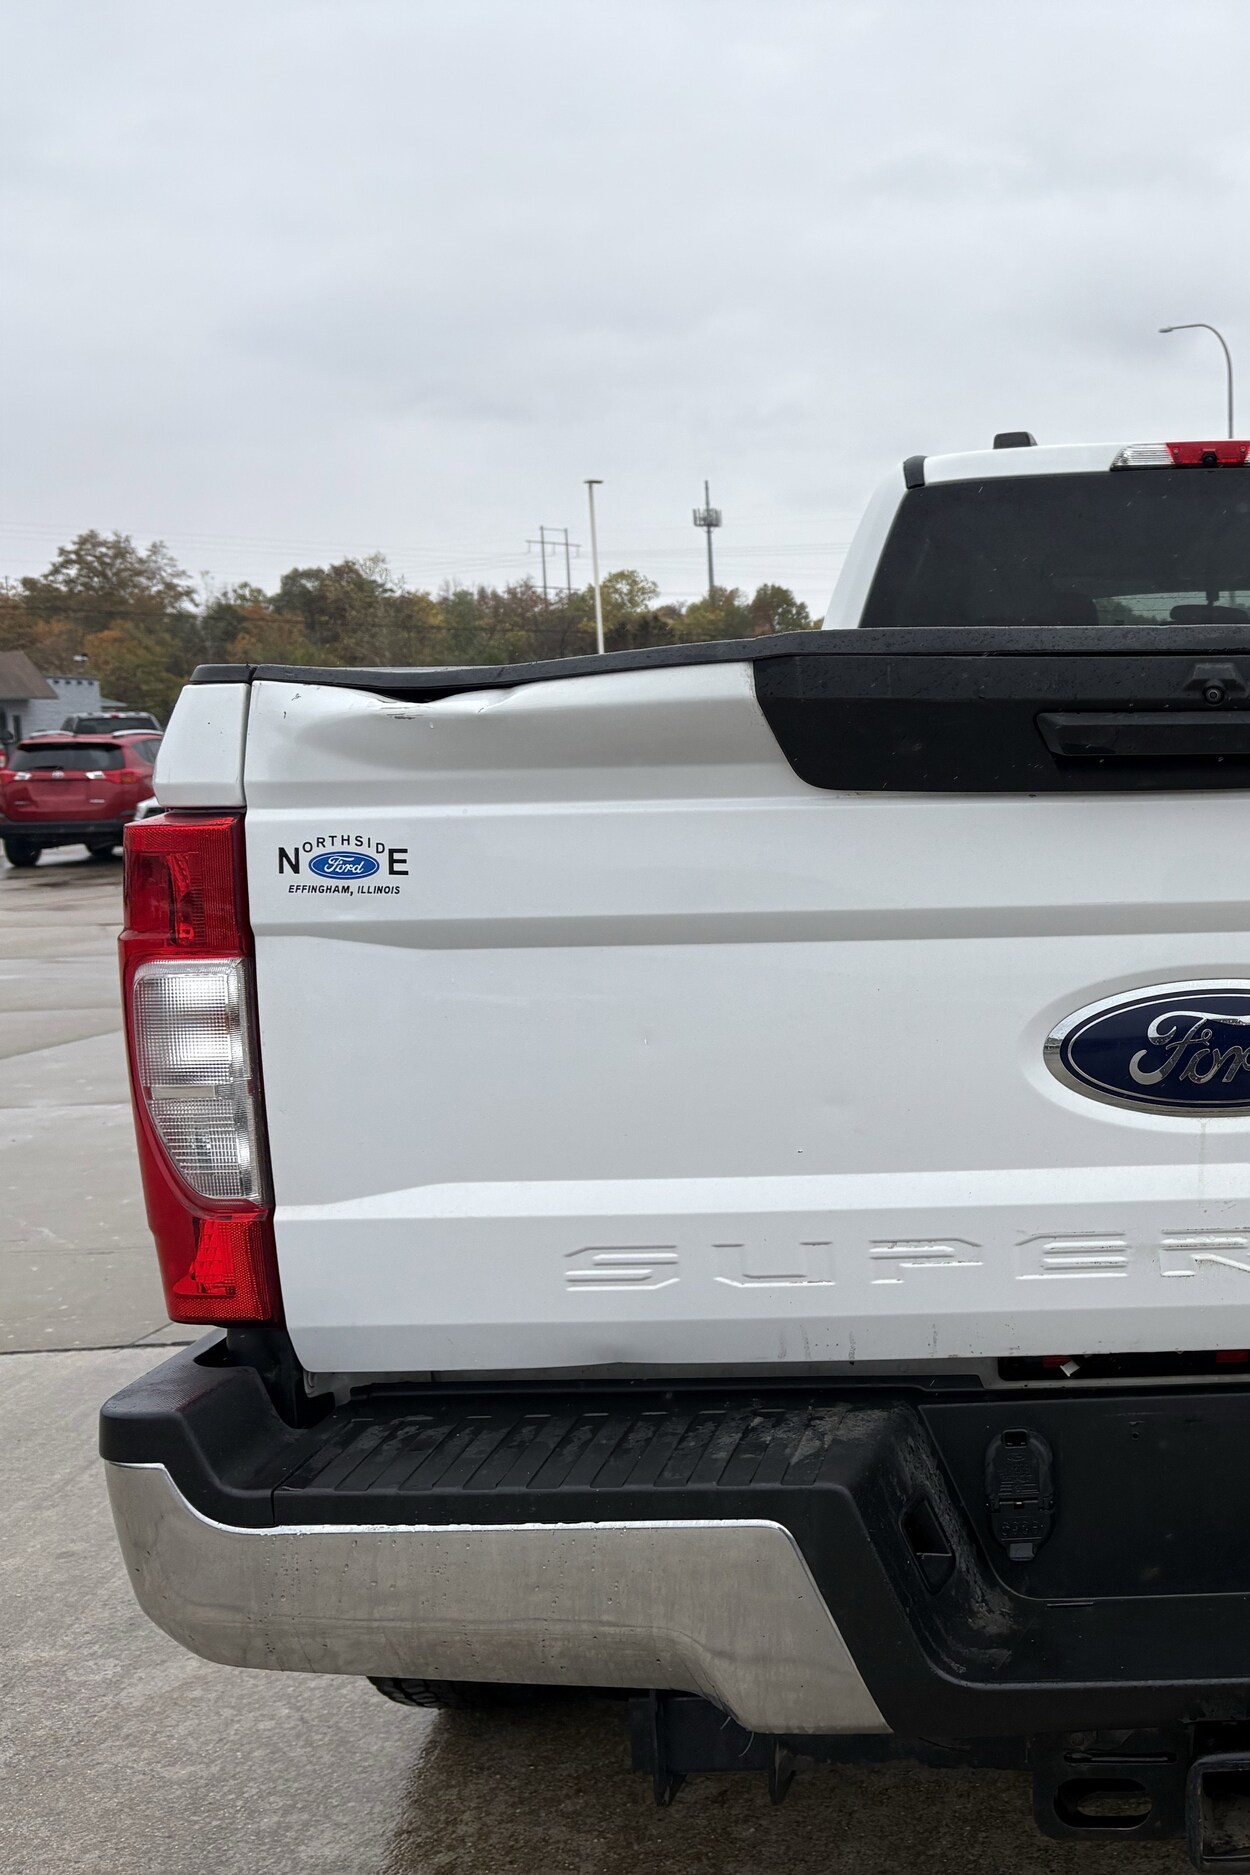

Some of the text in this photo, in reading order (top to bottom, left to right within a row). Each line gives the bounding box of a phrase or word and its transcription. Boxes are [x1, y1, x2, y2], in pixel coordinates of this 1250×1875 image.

[278, 835, 409, 876] NORTHSIDE
[324, 855, 364, 874] Ford
[288, 884, 401, 896] EFFINGHAM, ILLINOIS
